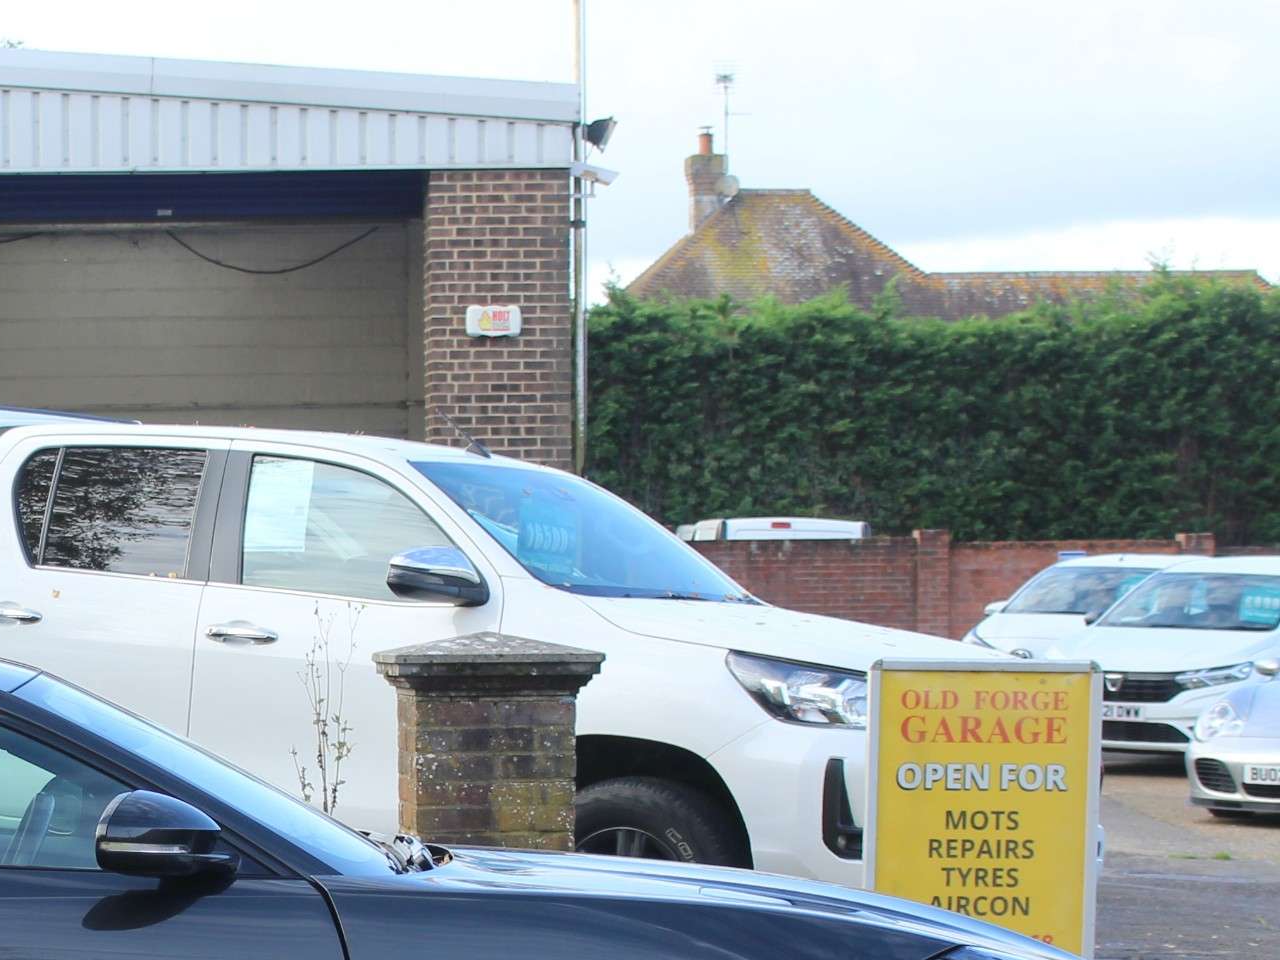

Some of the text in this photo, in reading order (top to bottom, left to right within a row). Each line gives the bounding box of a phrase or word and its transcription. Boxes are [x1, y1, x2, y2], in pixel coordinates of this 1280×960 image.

[901, 689, 1069, 711] OLD FORGE
[900, 715, 1068, 744] GARAGE
[896, 762, 1068, 792] OPEN FOR
[1250, 767, 1280, 782] BU0
[945, 810, 1020, 831] MOTS
[928, 838, 1035, 860] REPAIRS
[940, 867, 1019, 888] TYRES
